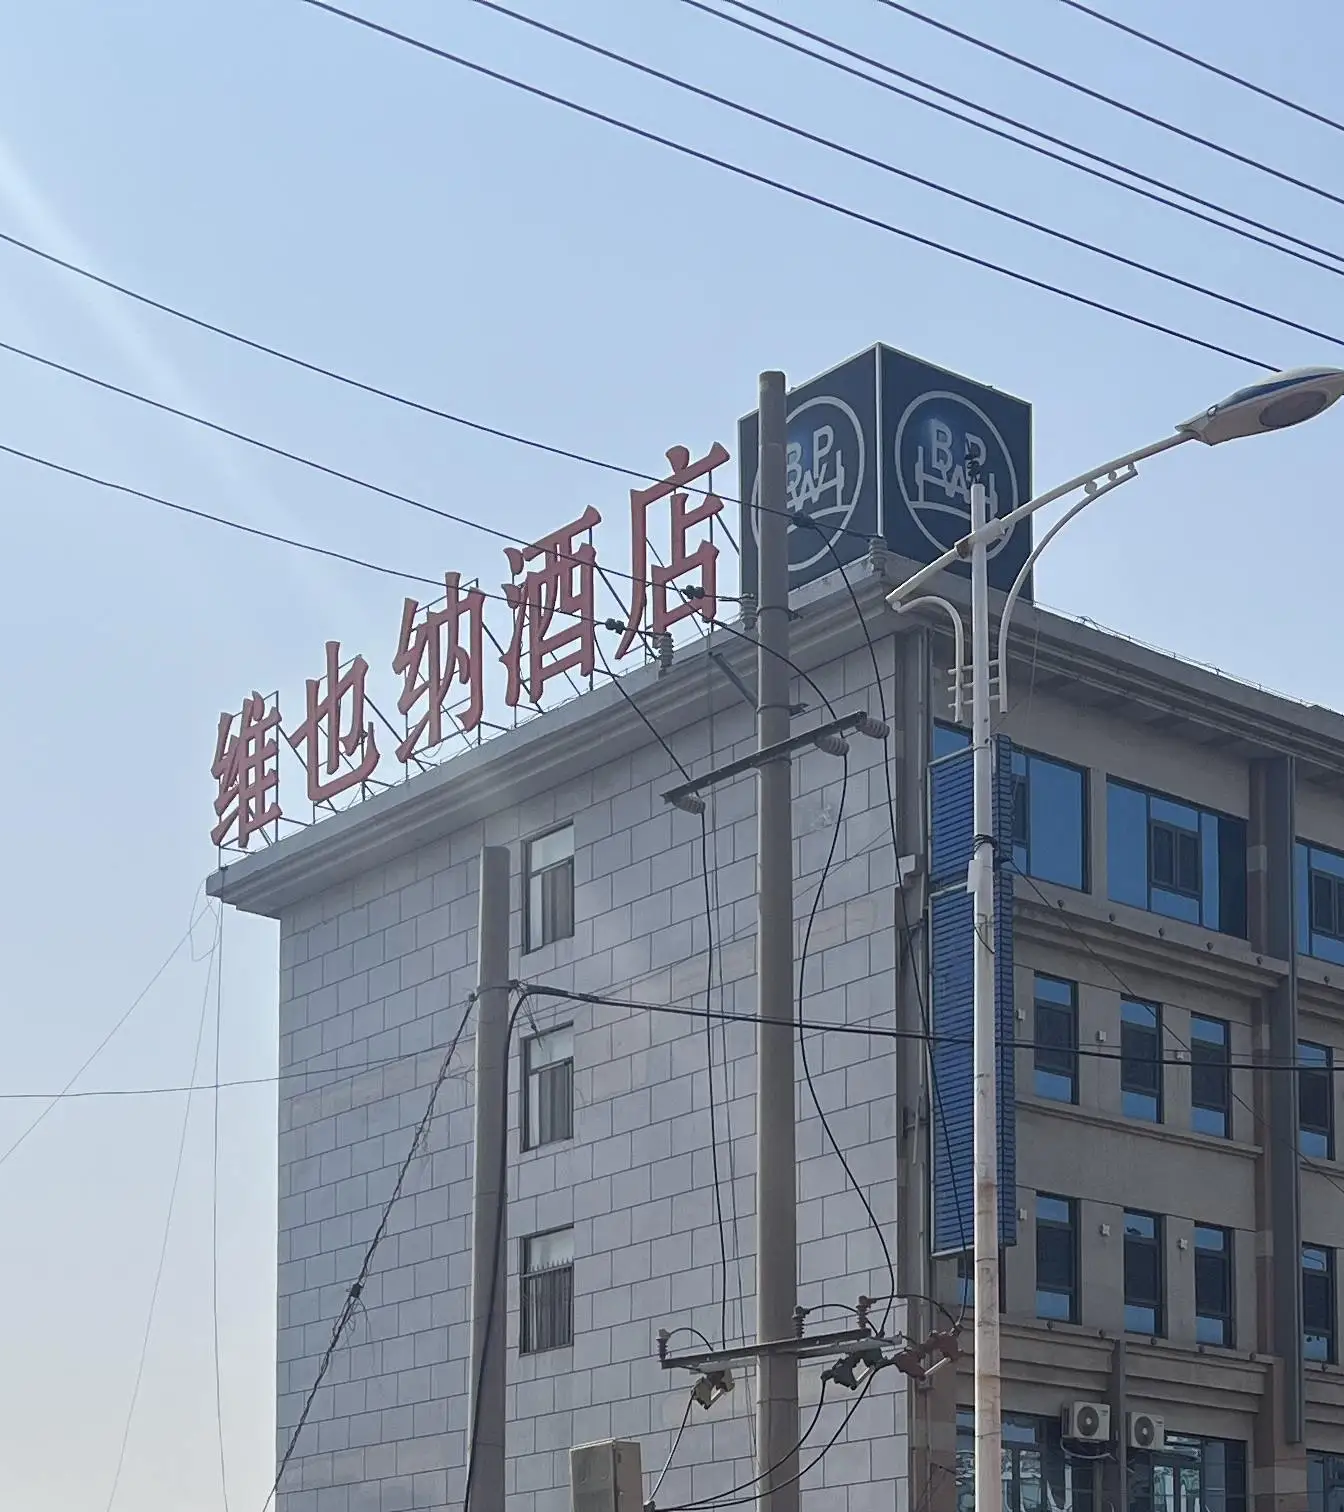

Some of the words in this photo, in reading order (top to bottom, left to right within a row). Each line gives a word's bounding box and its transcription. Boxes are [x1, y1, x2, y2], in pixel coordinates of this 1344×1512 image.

[211, 441, 731, 847] 维也纳酒店
